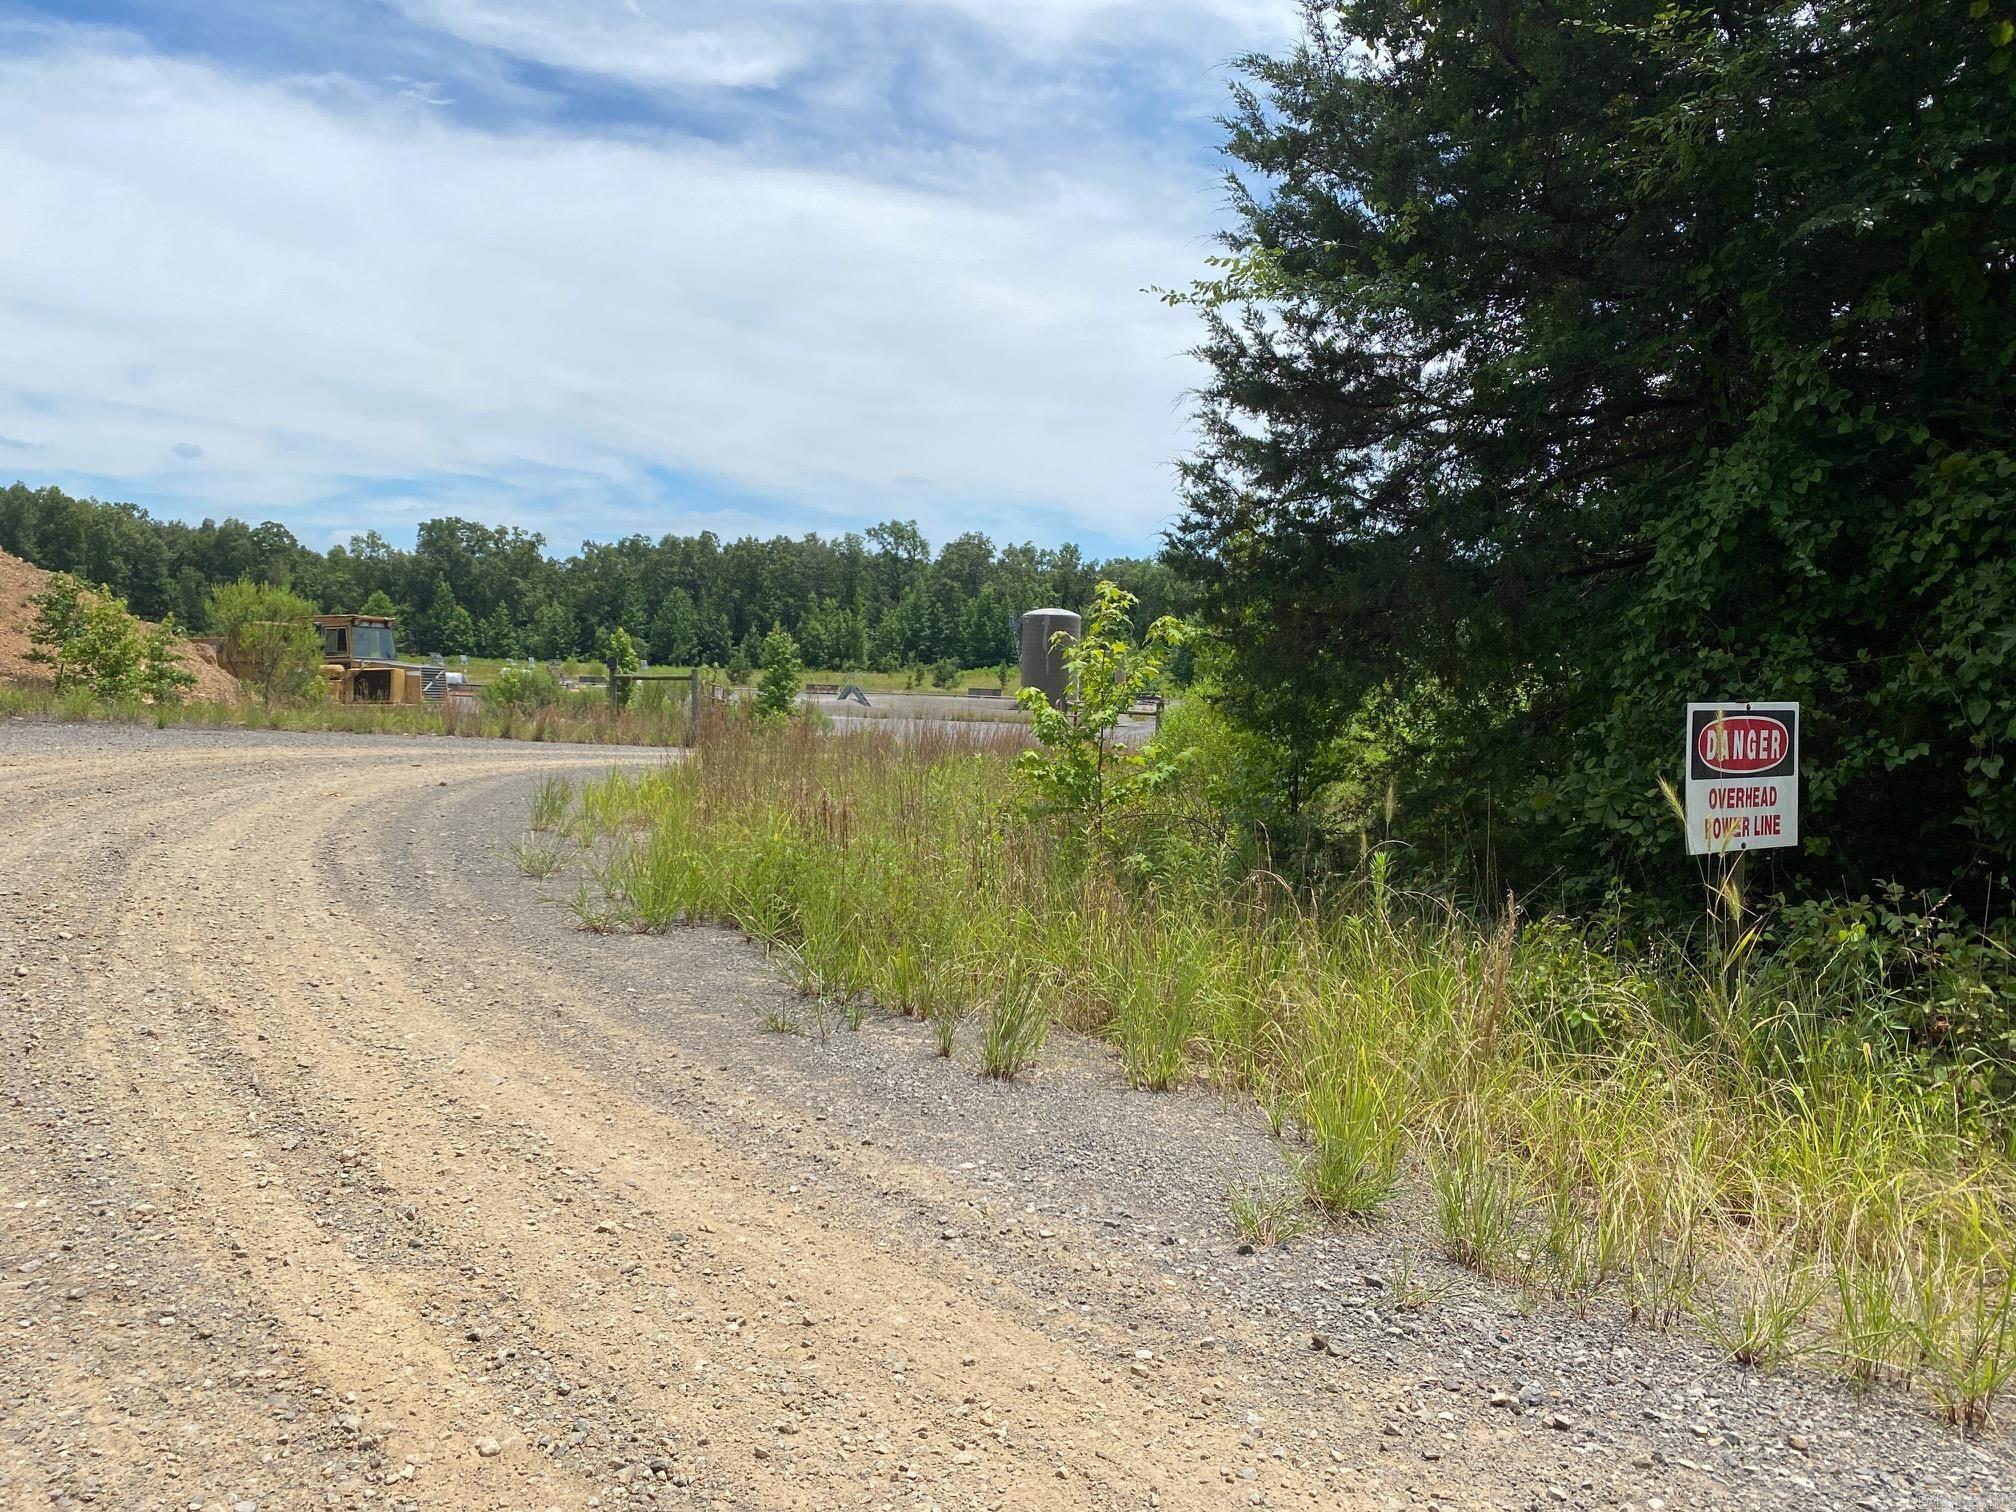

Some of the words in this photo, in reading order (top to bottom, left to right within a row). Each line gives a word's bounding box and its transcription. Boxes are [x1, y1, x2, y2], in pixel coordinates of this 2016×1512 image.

[1706, 730, 1780, 760] DANGER
[1709, 786, 1777, 809] OVERHEAD
[1754, 815, 1780, 836] LINE
